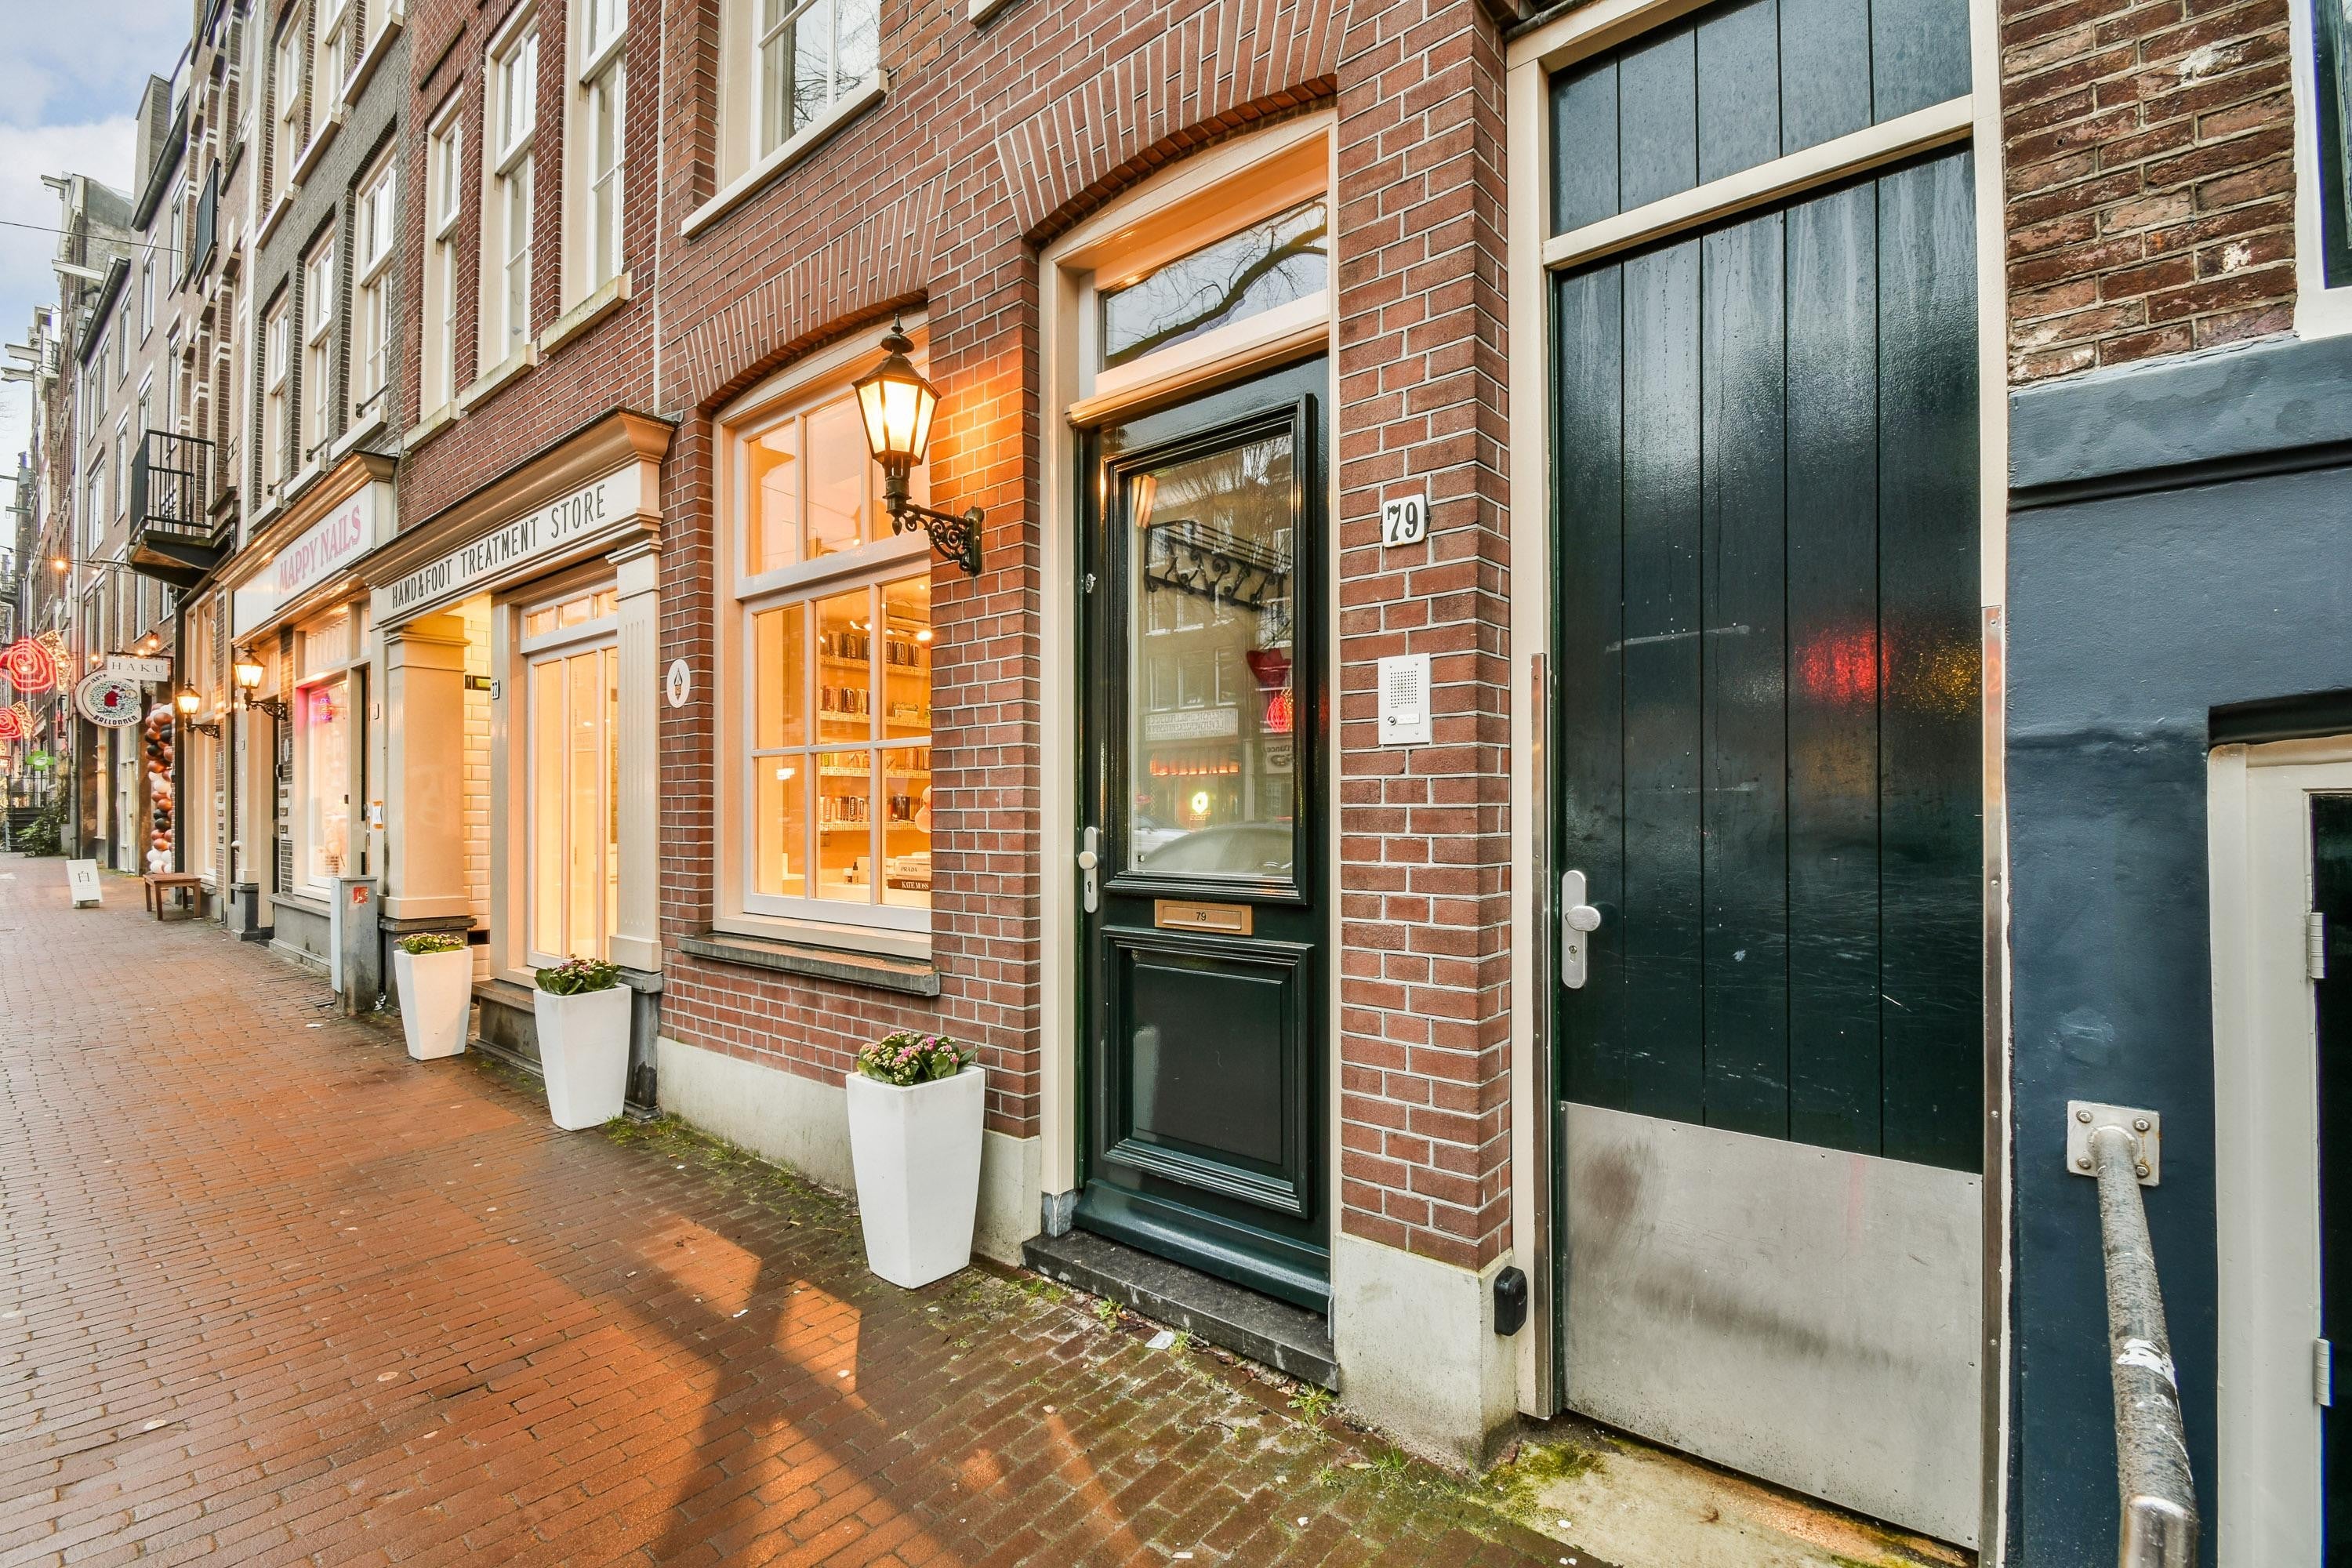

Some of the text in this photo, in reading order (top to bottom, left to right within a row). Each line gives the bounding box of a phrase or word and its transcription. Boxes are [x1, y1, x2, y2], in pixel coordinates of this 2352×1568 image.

[1387, 501, 1418, 542] 79
[320, 504, 361, 568] NAILS
[460, 516, 539, 578] TREATMENT
[551, 484, 605, 539] STORE
[112, 662, 164, 673] HAKU
[93, 715, 138, 725] BALLONNEN
[902, 880, 929, 890] KATE MOSS
[1196, 912, 1207, 921] 79
